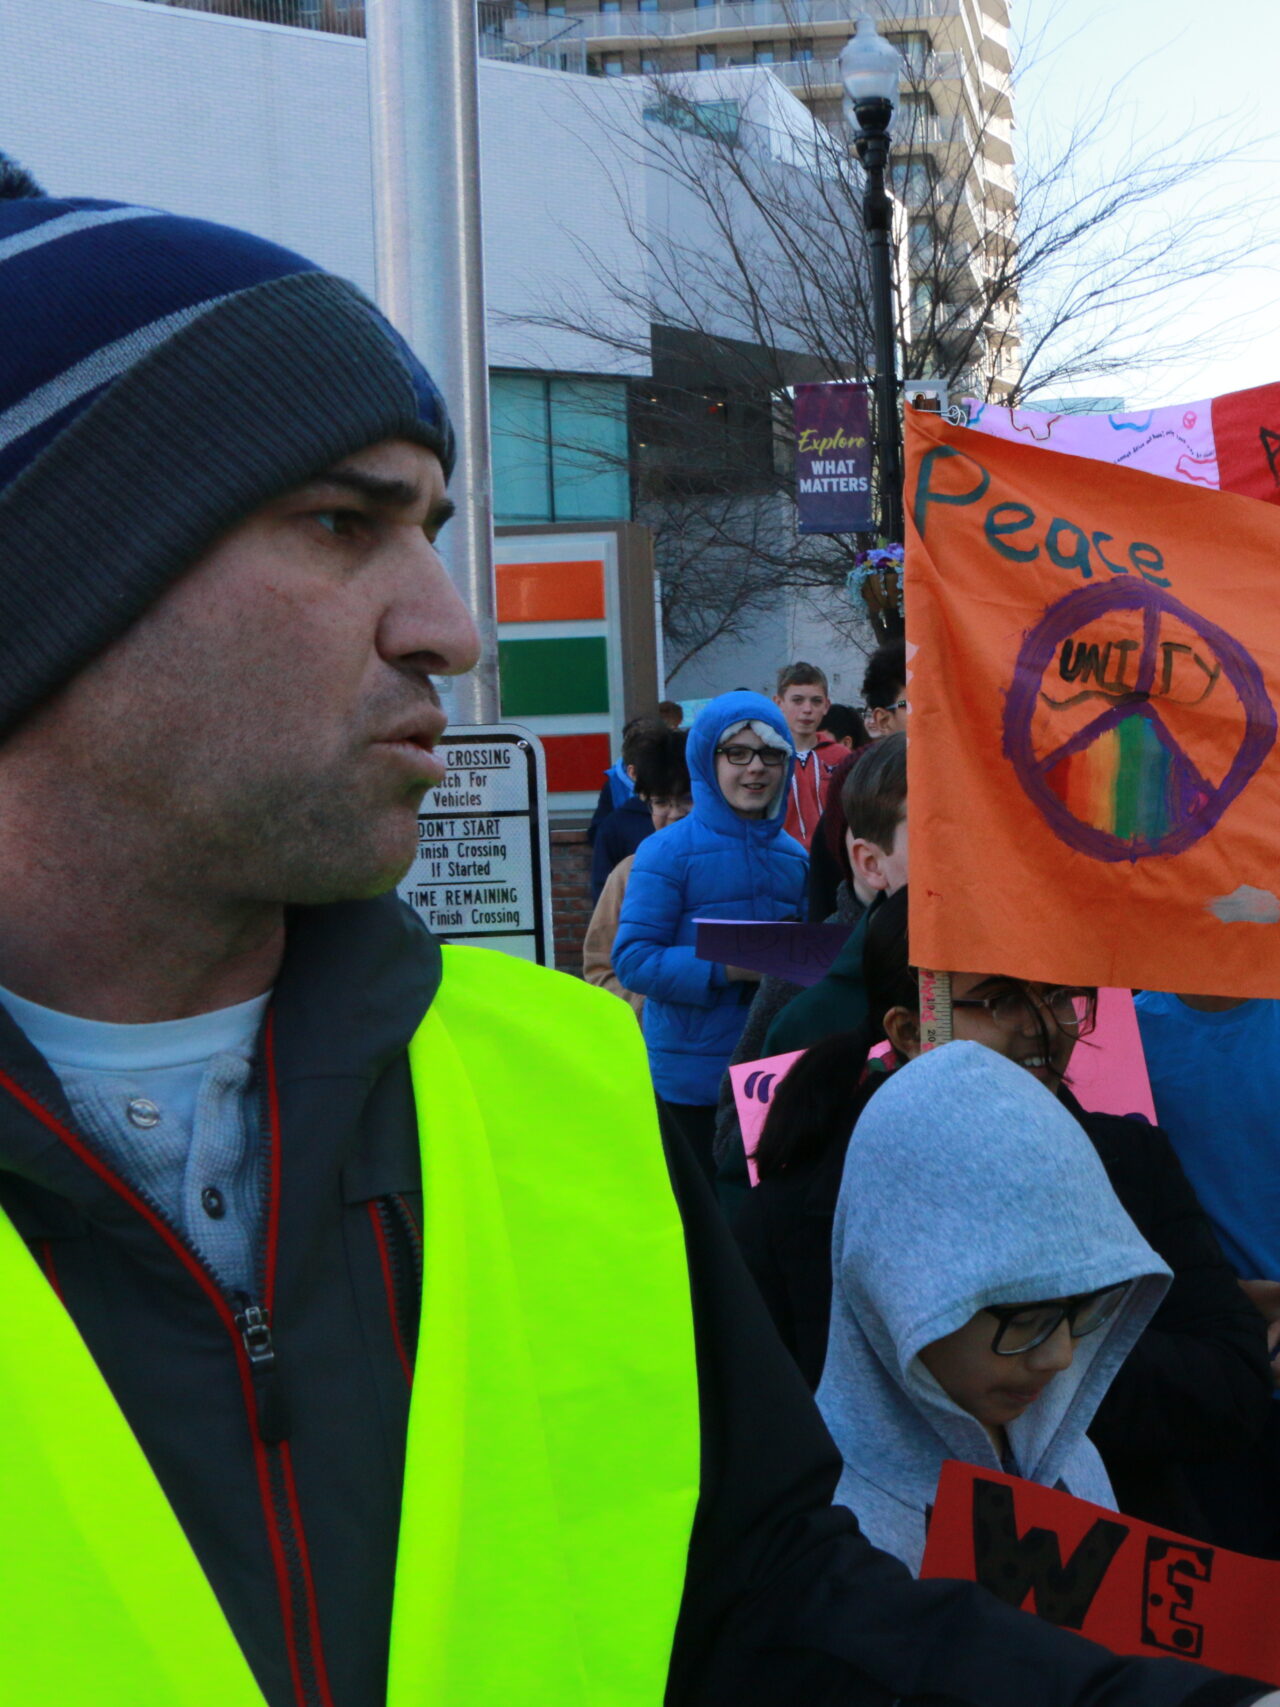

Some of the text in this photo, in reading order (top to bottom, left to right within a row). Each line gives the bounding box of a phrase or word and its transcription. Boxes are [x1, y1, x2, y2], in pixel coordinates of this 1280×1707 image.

[798, 427, 866, 457] Explore
[811, 460, 855, 475] WHAT
[800, 477, 868, 493] MATTERS
[914, 445, 1172, 588] Peace
[1059, 638, 1221, 698] UNITY
[447, 749, 511, 767] CROSSING
[469, 771, 487, 787] For
[433, 791, 482, 807] Vehicles
[417, 819, 501, 838] DON'T START
[418, 842, 506, 860] inish Crossing
[431, 861, 490, 877] If Started
[408, 888, 518, 907] TIME REMAINING
[430, 907, 520, 927] Finish Crossing
[927, 1029, 937, 1043] 20
[973, 1477, 1215, 1659] WE
